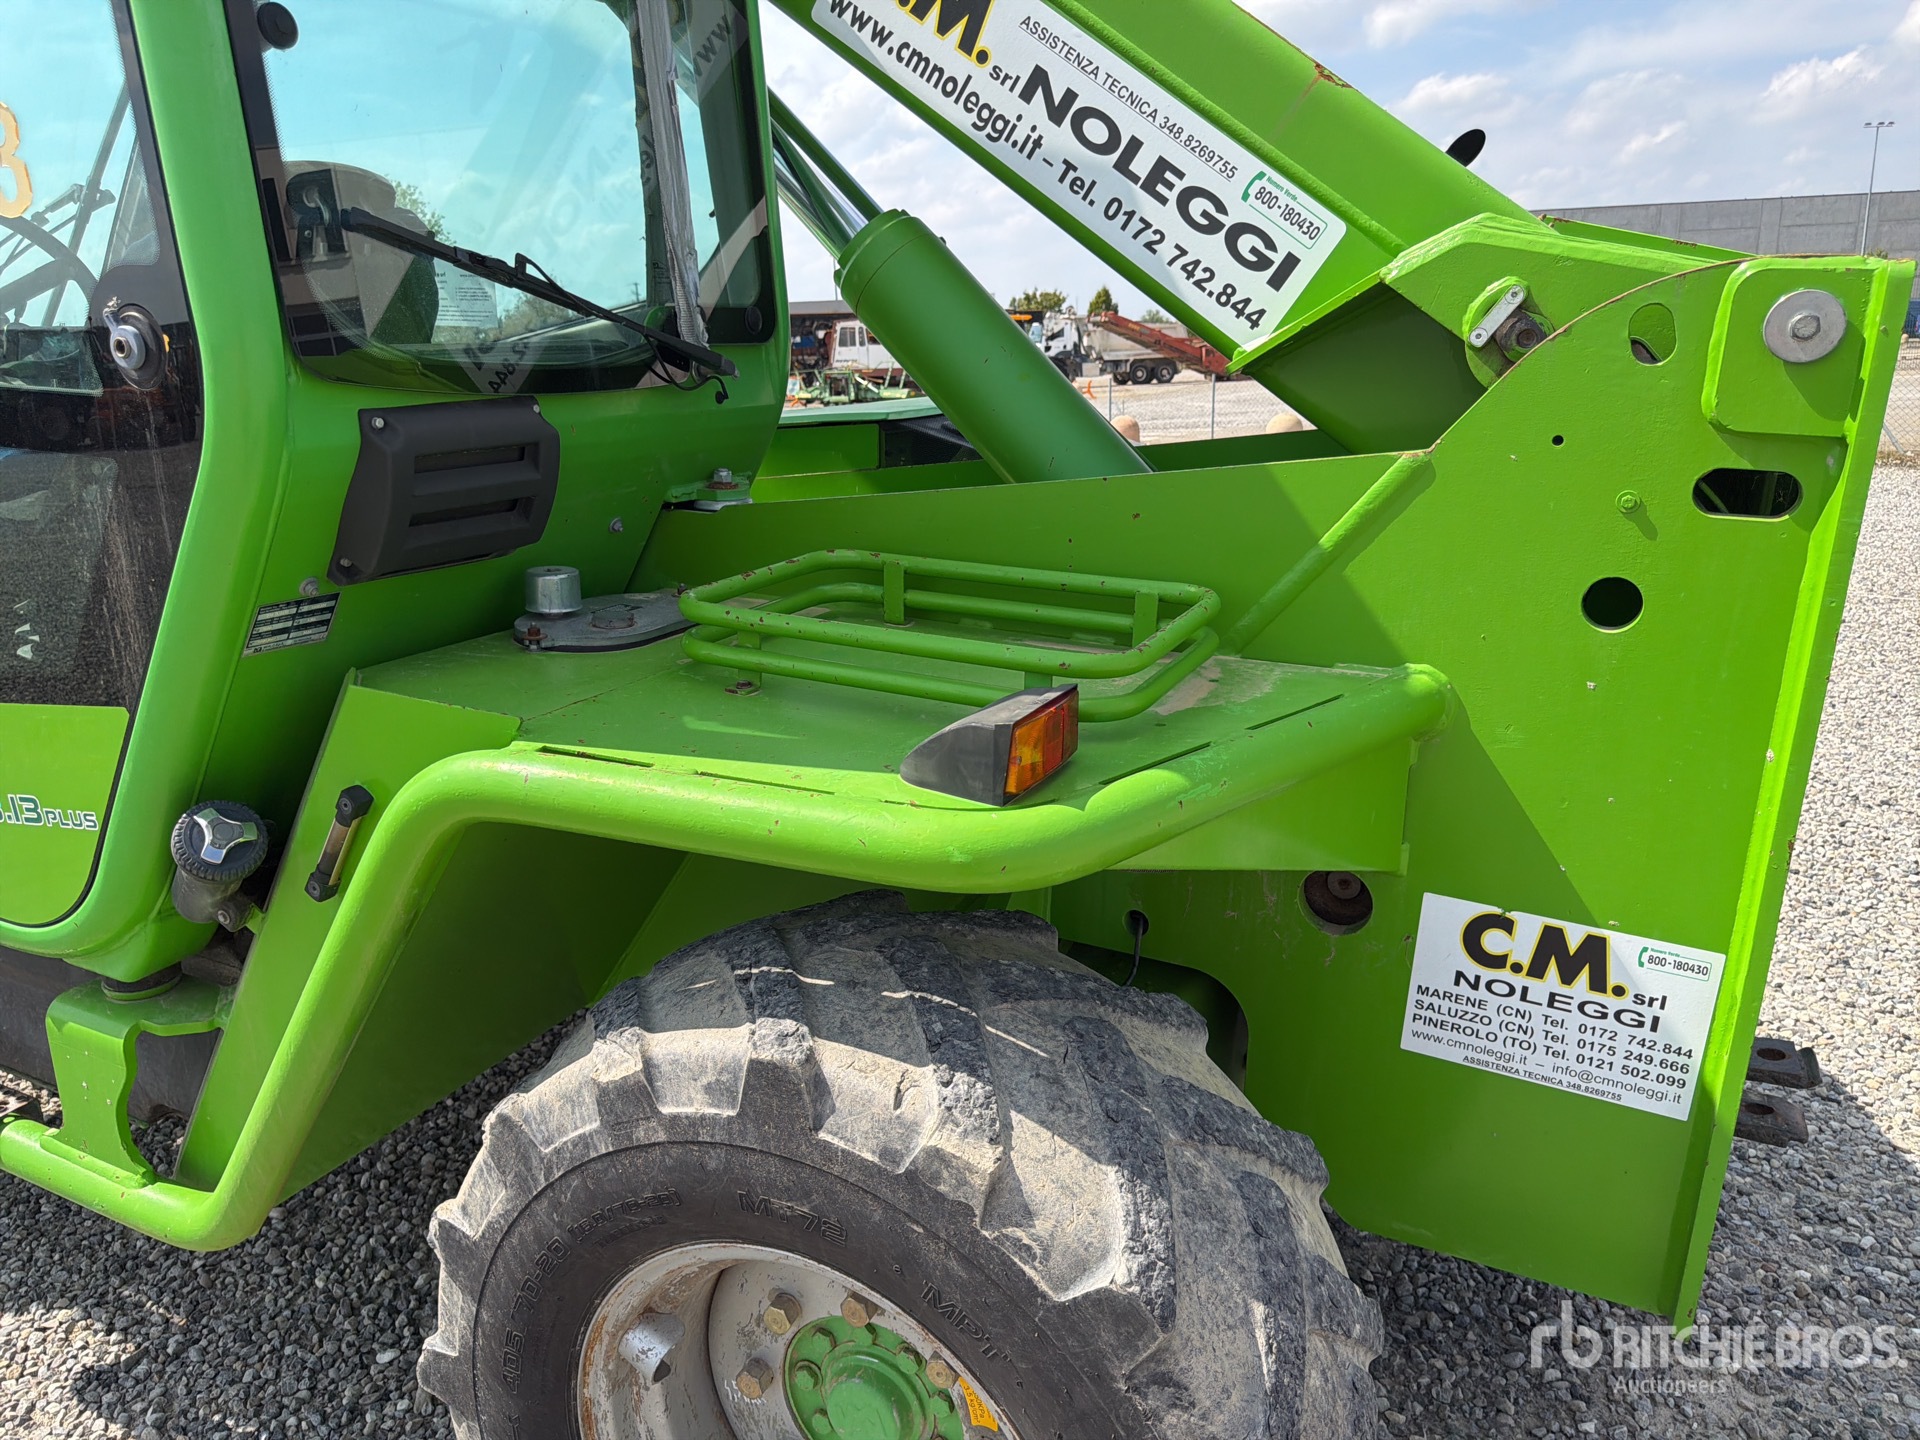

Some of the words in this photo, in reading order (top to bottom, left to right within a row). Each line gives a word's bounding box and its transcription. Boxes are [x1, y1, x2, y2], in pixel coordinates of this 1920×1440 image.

[1019, 15, 1101, 80] ASSISTENZA
[1102, 72, 1159, 123] TECNICA
[1159, 116, 1239, 180] 348.8269755
[829, 0, 1043, 160] www.cmnoleggi.it
[1057, 158, 1097, 207] Tel.
[1103, 197, 1166, 255] 0172
[1166, 243, 1267, 331] 742.844
[989, 64, 1021, 93] srl
[1018, 64, 1301, 292] NOLEGGI
[1265, 175, 1285, 193] Numero
[1283, 188, 1298, 202] Verde
[1254, 186, 1321, 240] 800-180430
[0, 794, 43, 826] .13
[42, 808, 99, 831] PLUS
[1460, 910, 1629, 1000] C.M.
[1632, 993, 1668, 1011] srl
[1647, 954, 1709, 976] 800-180430
[1414, 999, 1492, 1027] SALUZZO
[1499, 1019, 1535, 1040] (CN)
[1542, 1029, 1569, 1046] Tel.
[1576, 1038, 1617, 1057] 0175
[1623, 1049, 1690, 1075] 249.666
[1416, 984, 1489, 1011] MARENE
[1496, 1003, 1533, 1023] (CN)
[1541, 1013, 1569, 1031] Tel.
[1578, 1023, 1618, 1042] 0172
[1627, 1034, 1693, 1060] 742.844
[1453, 970, 1661, 1033] NOLEGGI
[1411, 1029, 1528, 1066] www.cmnoleggi.it
[1552, 1062, 1682, 1104] info@cmnoleggi.it
[1412, 1013, 1498, 1043] PINEROLO
[1502, 1035, 1538, 1055] (TO)
[1542, 1044, 1570, 1062] Tel.
[1575, 1053, 1614, 1072] 0121
[1620, 1064, 1686, 1090] 502.099
[1462, 1055, 1520, 1077] ASSISTENZA
[1522, 1070, 1564, 1088] TECNICA
[1565, 1081, 1622, 1102] 348.8269755
